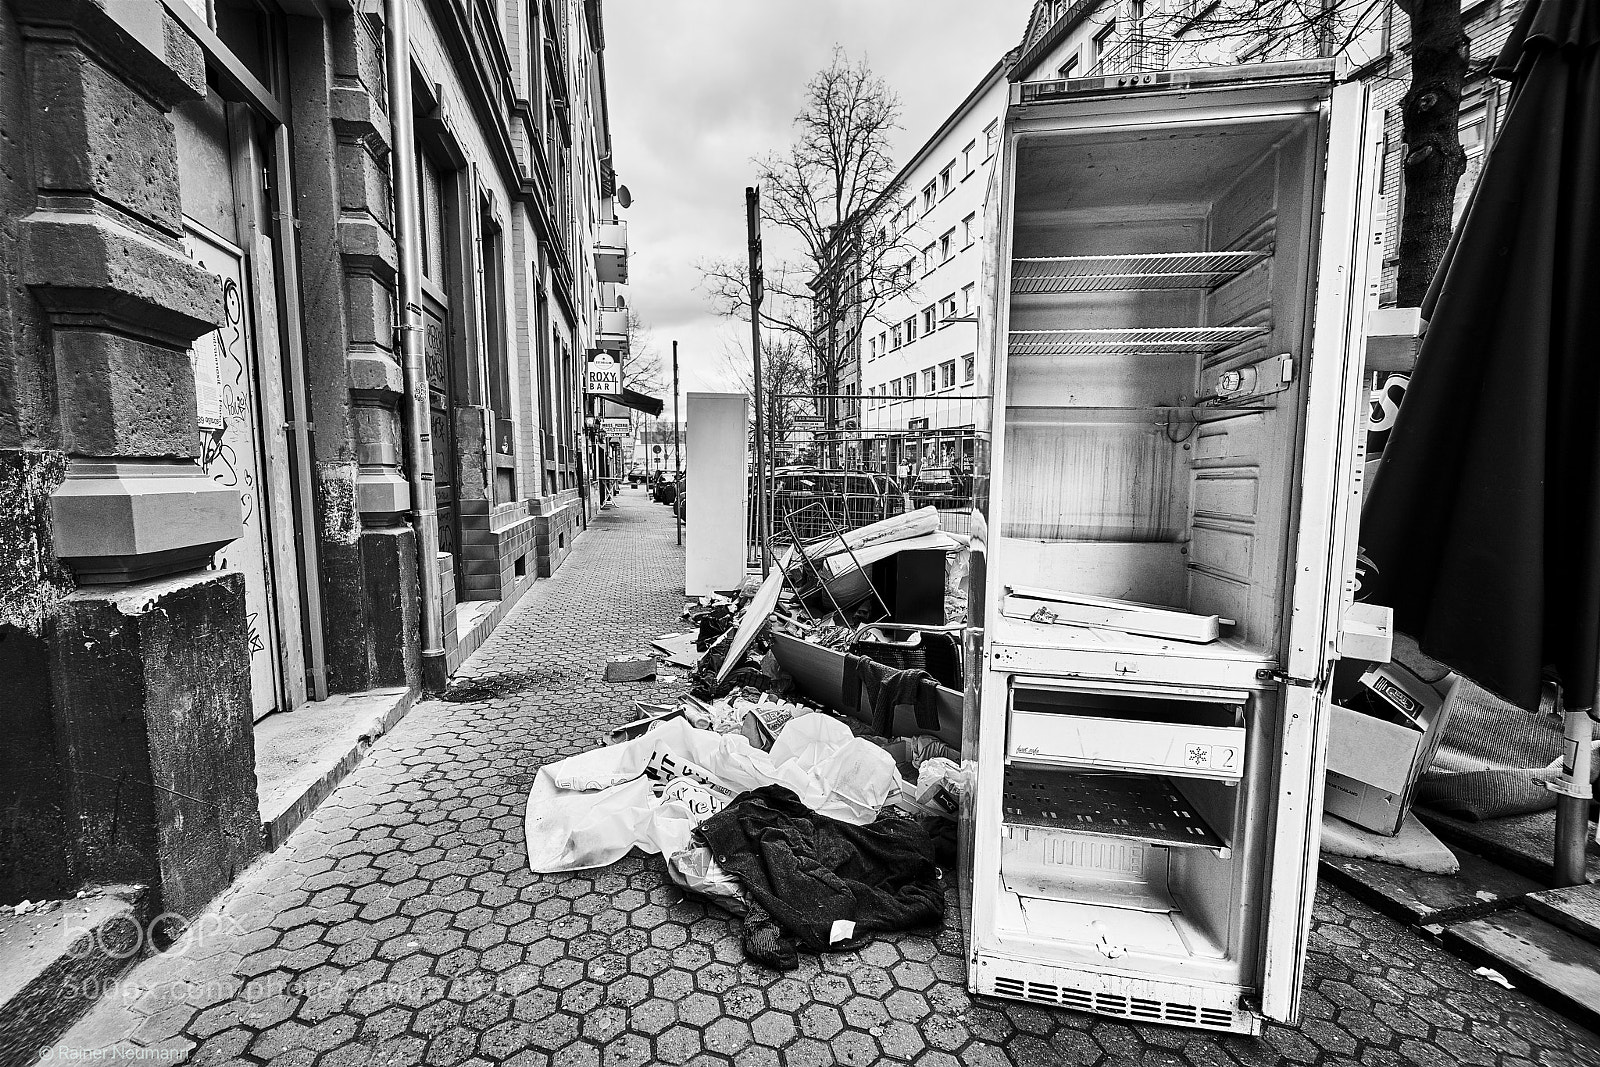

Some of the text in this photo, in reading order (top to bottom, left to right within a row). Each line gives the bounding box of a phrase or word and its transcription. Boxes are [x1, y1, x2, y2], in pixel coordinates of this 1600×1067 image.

[589, 371, 616, 382] ROXY
[589, 383, 610, 391] BAR
[1222, 748, 1234, 768] 2
